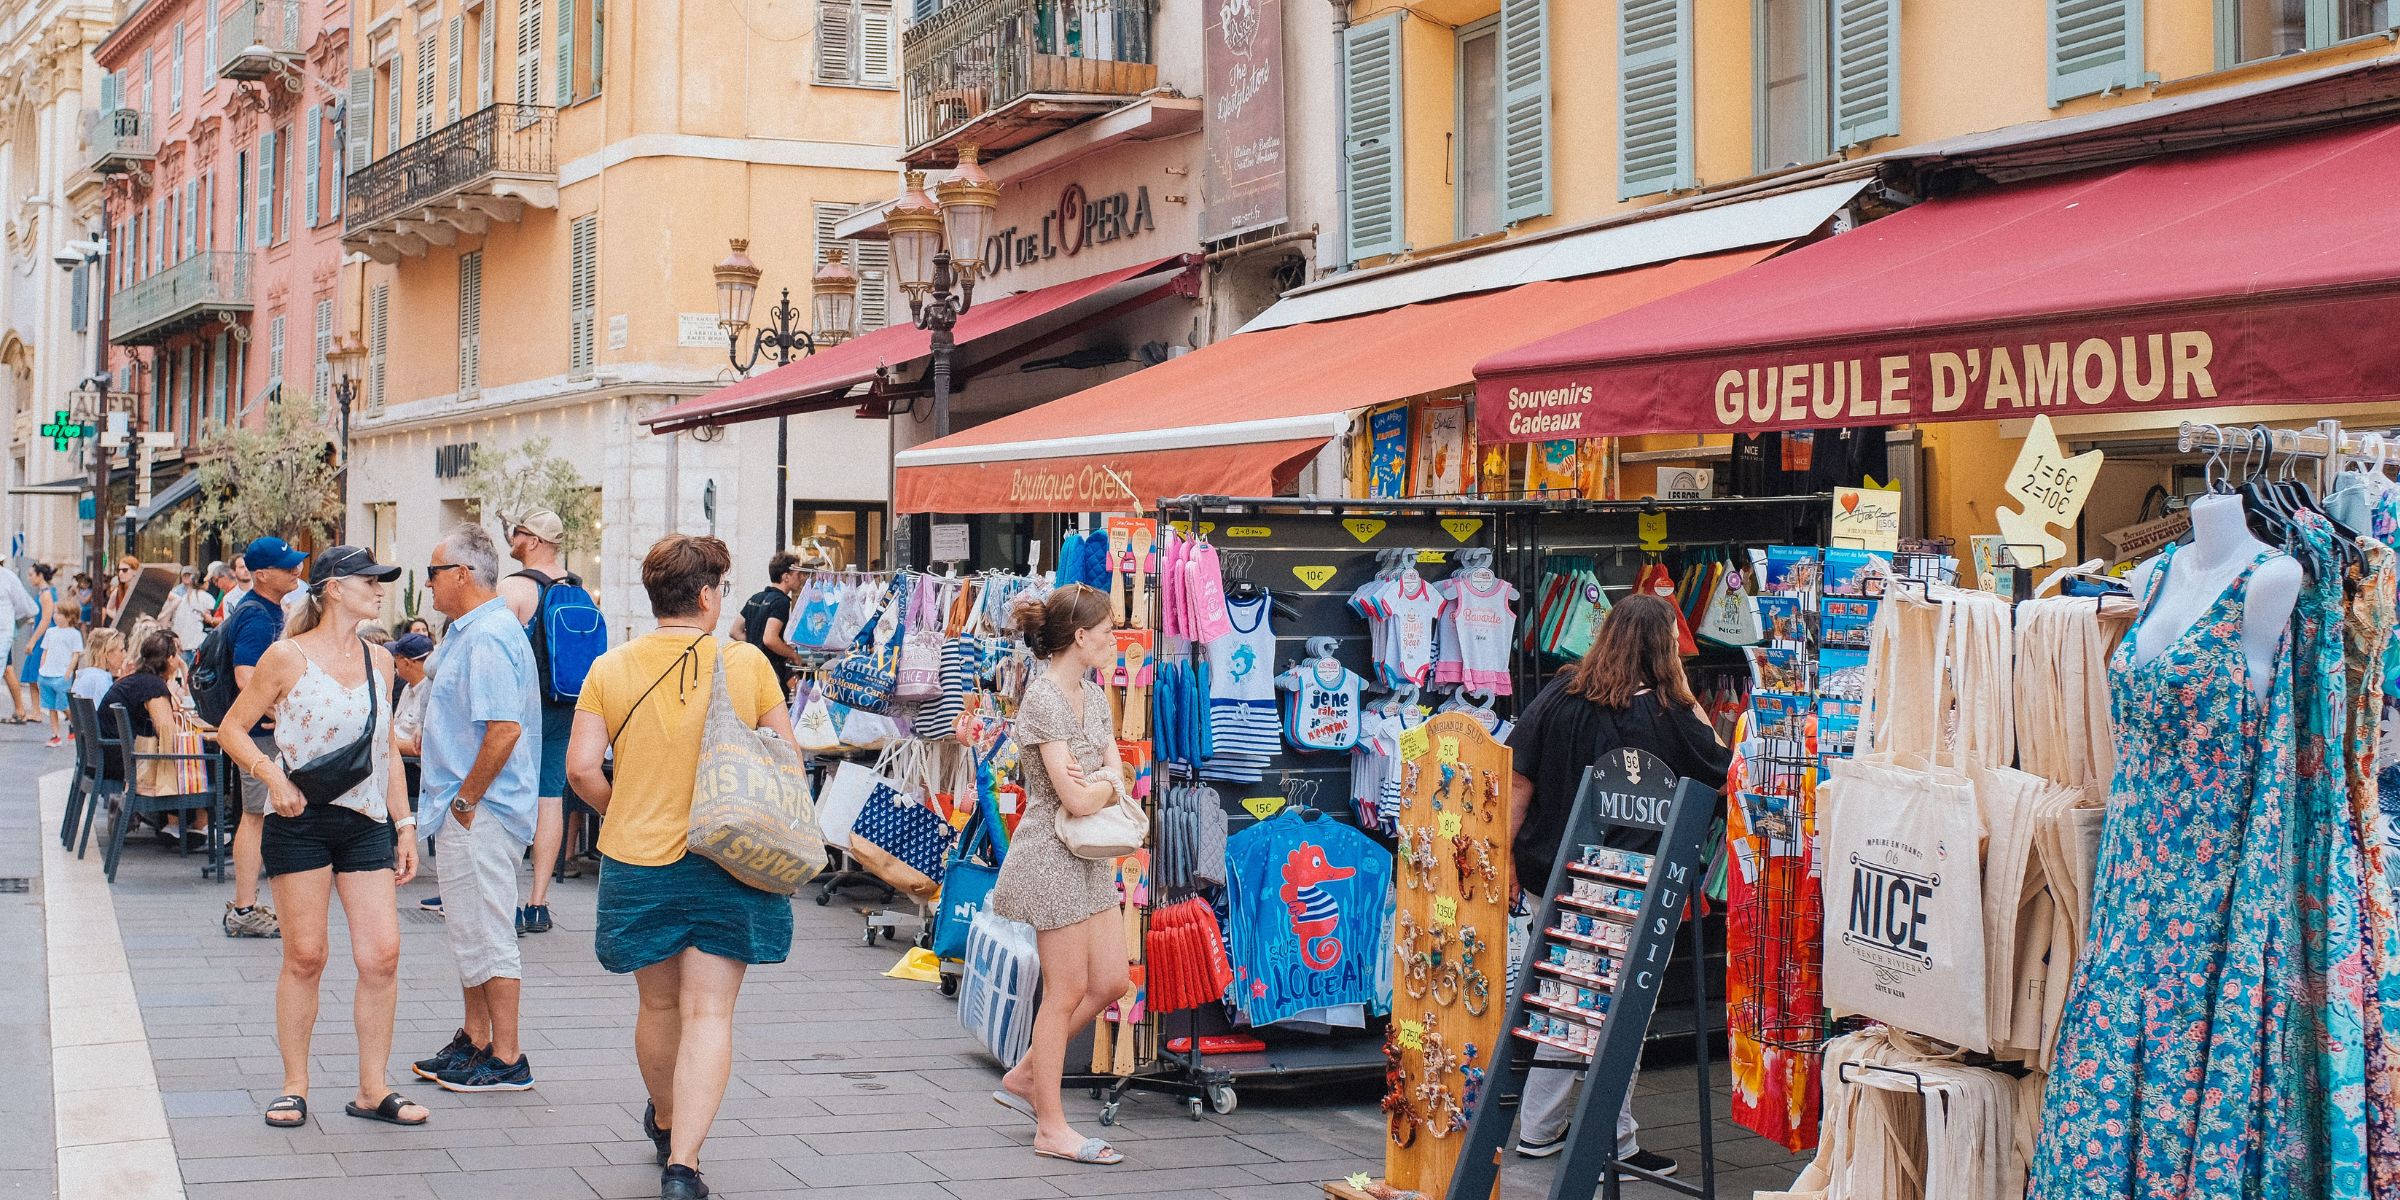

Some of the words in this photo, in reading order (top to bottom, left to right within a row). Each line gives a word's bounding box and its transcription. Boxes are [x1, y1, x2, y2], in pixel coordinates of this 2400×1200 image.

[1229, 62, 1247, 87] The
[1714, 354, 1911, 425] GUEULE
[1929, 330, 2218, 413] D’AMOUR
[1507, 381, 1593, 411] Souvenirs
[1509, 410, 1583, 435] Cadeaux
[1744, 445, 1759, 456] NICE
[1794, 457, 1808, 465] NICE
[1010, 464, 1075, 508] Boutique
[1078, 460, 1133, 507] Opéra
[1356, 523, 1373, 534] 15€
[1453, 522, 1472, 533] 20€
[2120, 521, 2189, 553] BIENVENUS
[1306, 570, 1324, 582] 10€
[1718, 626, 1741, 635] NICE
[1310, 689, 1330, 710] je
[1332, 692, 1349, 708] ne
[1318, 706, 1336, 718] râle
[1336, 709, 1348, 719] pas
[1310, 718, 1321, 729] je
[1465, 723, 1484, 745] SUD
[746, 766, 813, 824] PARIS
[1255, 802, 1273, 814] 15€
[1599, 790, 1672, 826] MUSIC
[1885, 849, 1899, 865] 06
[1891, 840, 1899, 849] EN
[1900, 843, 1924, 861] FRANCE
[1849, 866, 1933, 953] NICE
[1636, 861, 1688, 990] MUSIC
[1852, 946, 1883, 964] FRENCH
[1887, 957, 1923, 975] RIVIERA
